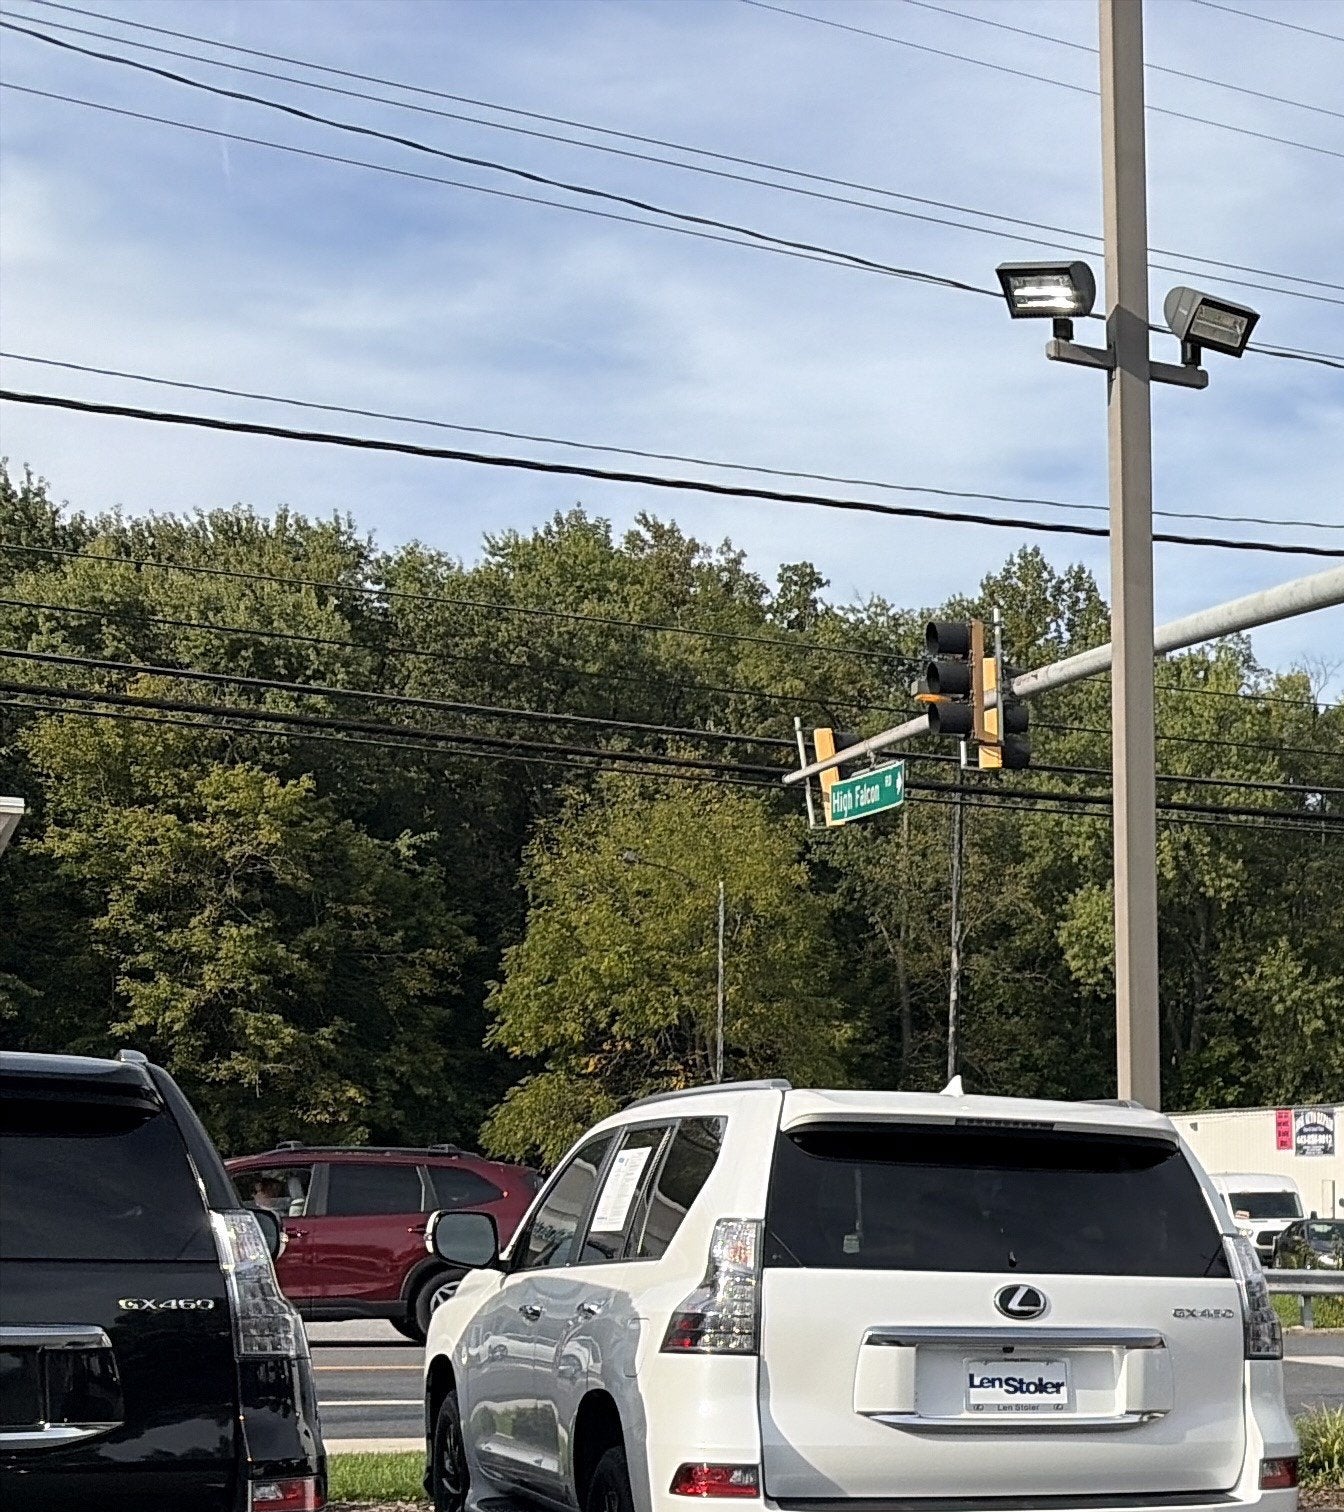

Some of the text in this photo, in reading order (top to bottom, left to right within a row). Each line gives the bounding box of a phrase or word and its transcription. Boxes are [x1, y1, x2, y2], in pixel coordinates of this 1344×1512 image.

[832, 788, 853, 817] High
[855, 783, 880, 808] Falcon
[118, 1298, 215, 1310] GX460
